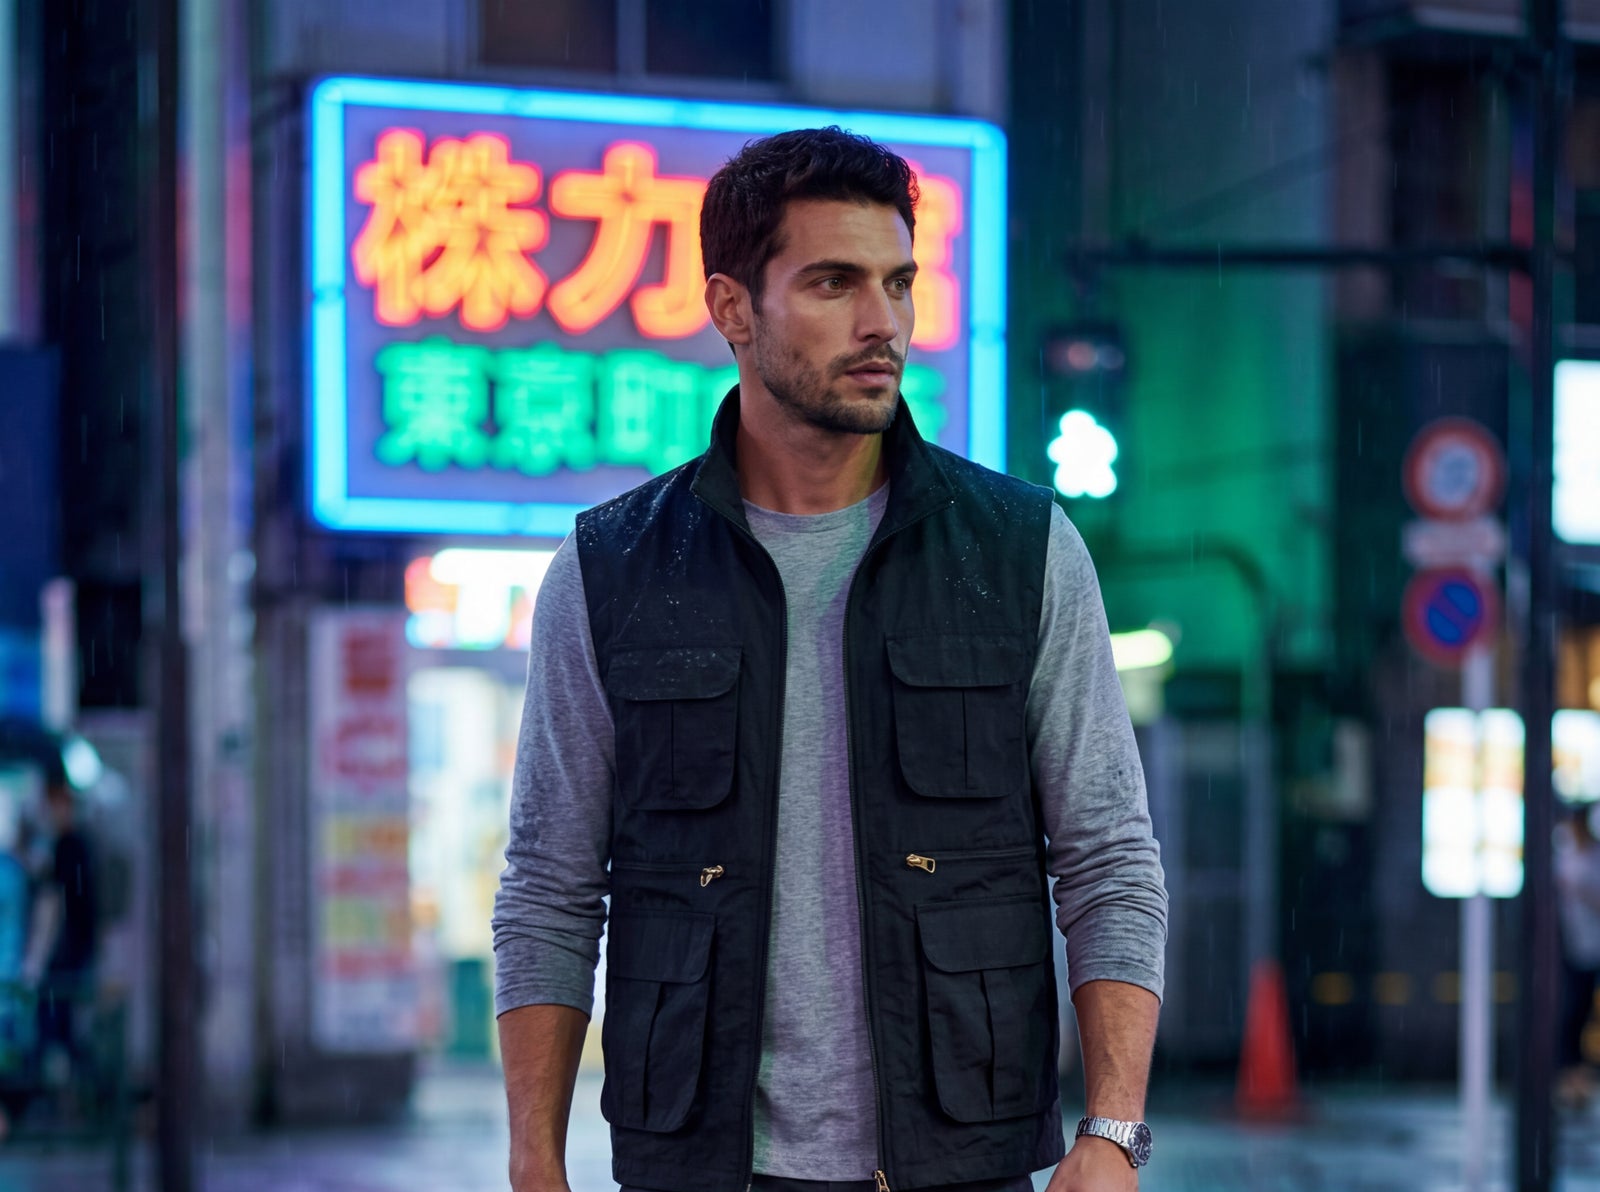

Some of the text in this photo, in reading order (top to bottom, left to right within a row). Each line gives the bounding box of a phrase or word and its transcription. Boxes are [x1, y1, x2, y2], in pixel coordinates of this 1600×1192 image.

[354, 127, 963, 350] 株力
[376, 337, 946, 476] 東京町
